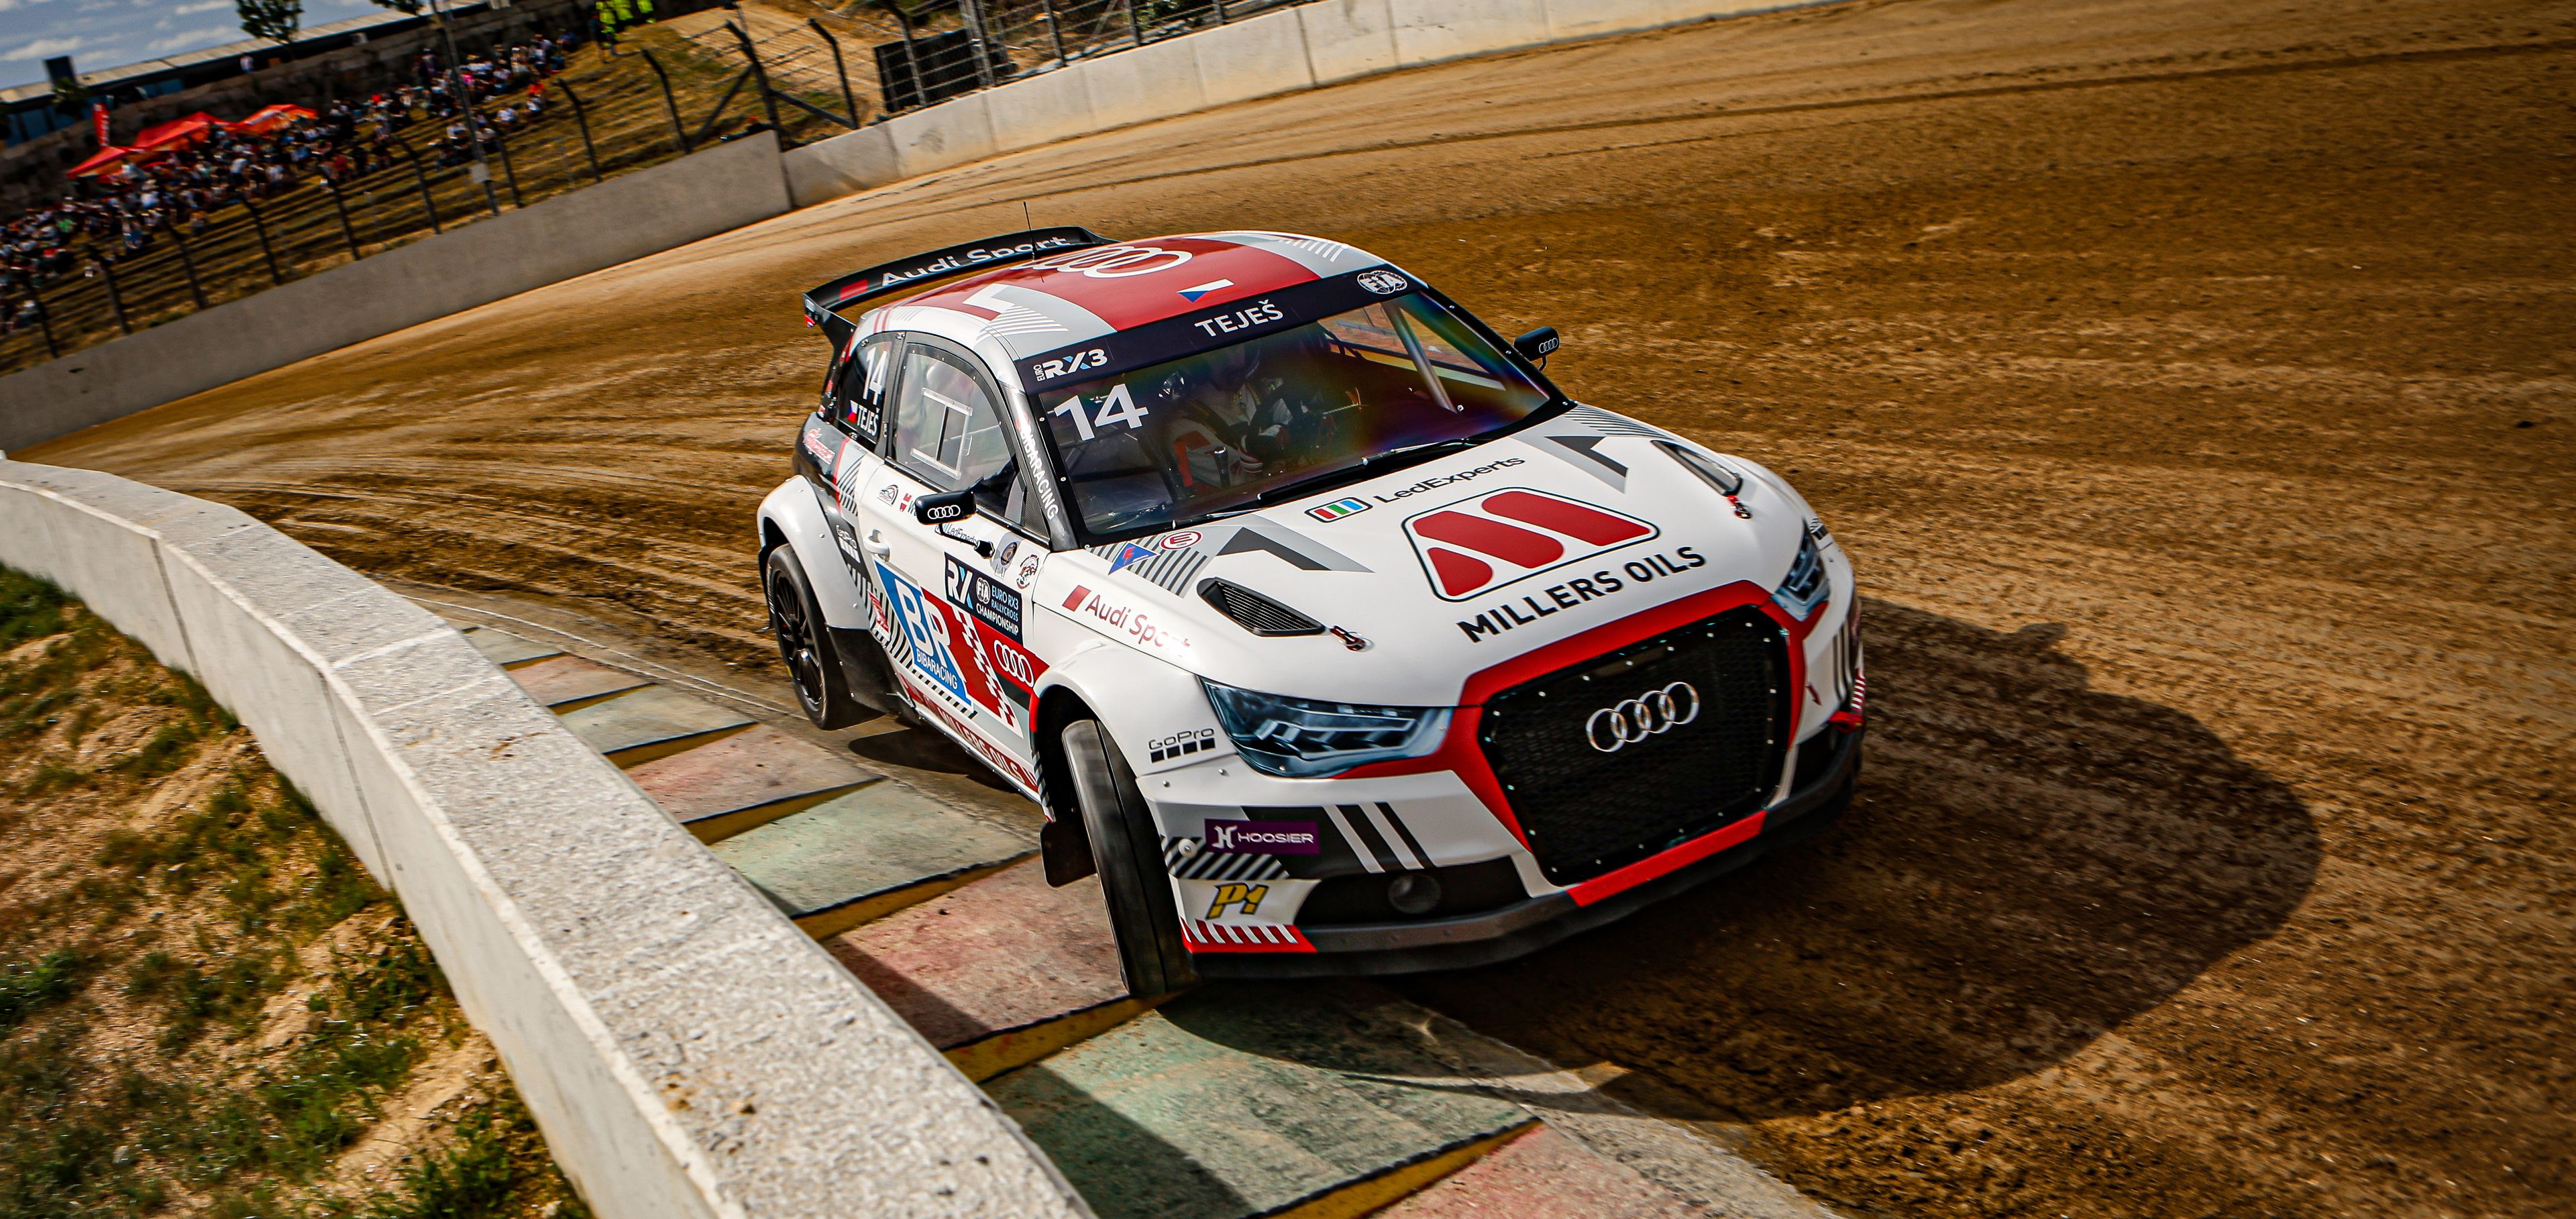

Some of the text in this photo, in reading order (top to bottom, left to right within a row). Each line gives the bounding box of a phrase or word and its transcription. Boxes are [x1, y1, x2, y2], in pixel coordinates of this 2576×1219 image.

[882, 237, 1071, 286] Audi Sport
[1358, 272, 1406, 293] FIA
[1194, 299, 1283, 337] TEJEŠ
[863, 346, 888, 405] 14
[1033, 364, 1045, 381] EURO
[1042, 349, 1108, 379] RX3
[857, 405, 880, 436] TEJEŠ
[1054, 383, 1148, 441] 14
[1373, 457, 1525, 503] LedExperts
[948, 560, 973, 610] RX
[977, 579, 990, 603] FIA
[991, 585, 1019, 611] EURO RX3
[1456, 546, 1706, 643] MILLERS OILS
[895, 578, 957, 670] BR
[976, 602, 1019, 636] CHAMPIONSHIP
[991, 599, 1019, 622] RALLYCROSS
[1085, 594, 1132, 629] Audi
[916, 648, 958, 690] BIBARACING
[1148, 728, 1214, 750] GoPro
[989, 747, 1025, 784] OILS
[1238, 832, 1314, 844] HOOSIER
